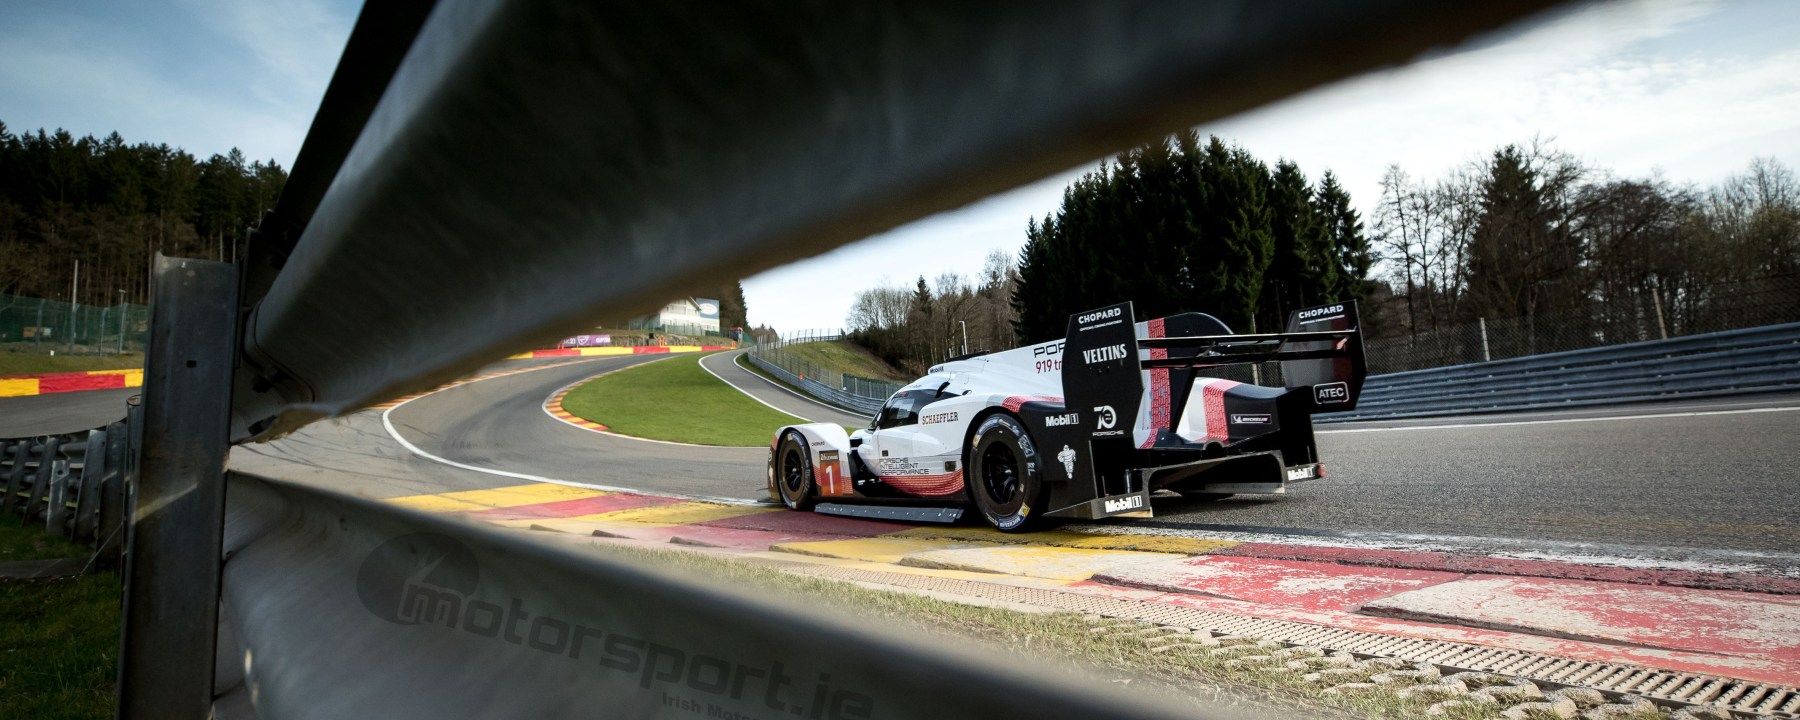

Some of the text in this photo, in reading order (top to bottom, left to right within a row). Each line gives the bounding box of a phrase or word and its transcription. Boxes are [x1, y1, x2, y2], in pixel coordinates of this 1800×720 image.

[1078, 308, 1121, 324] CHOPARD
[1299, 305, 1343, 318] CHOPARD
[1083, 344, 1127, 364] VELTINS
[1035, 358, 1052, 374] 919
[1318, 388, 1345, 399] ATEC
[922, 411, 959, 426] SCHAEFFLER
[826, 466, 835, 494] 1
